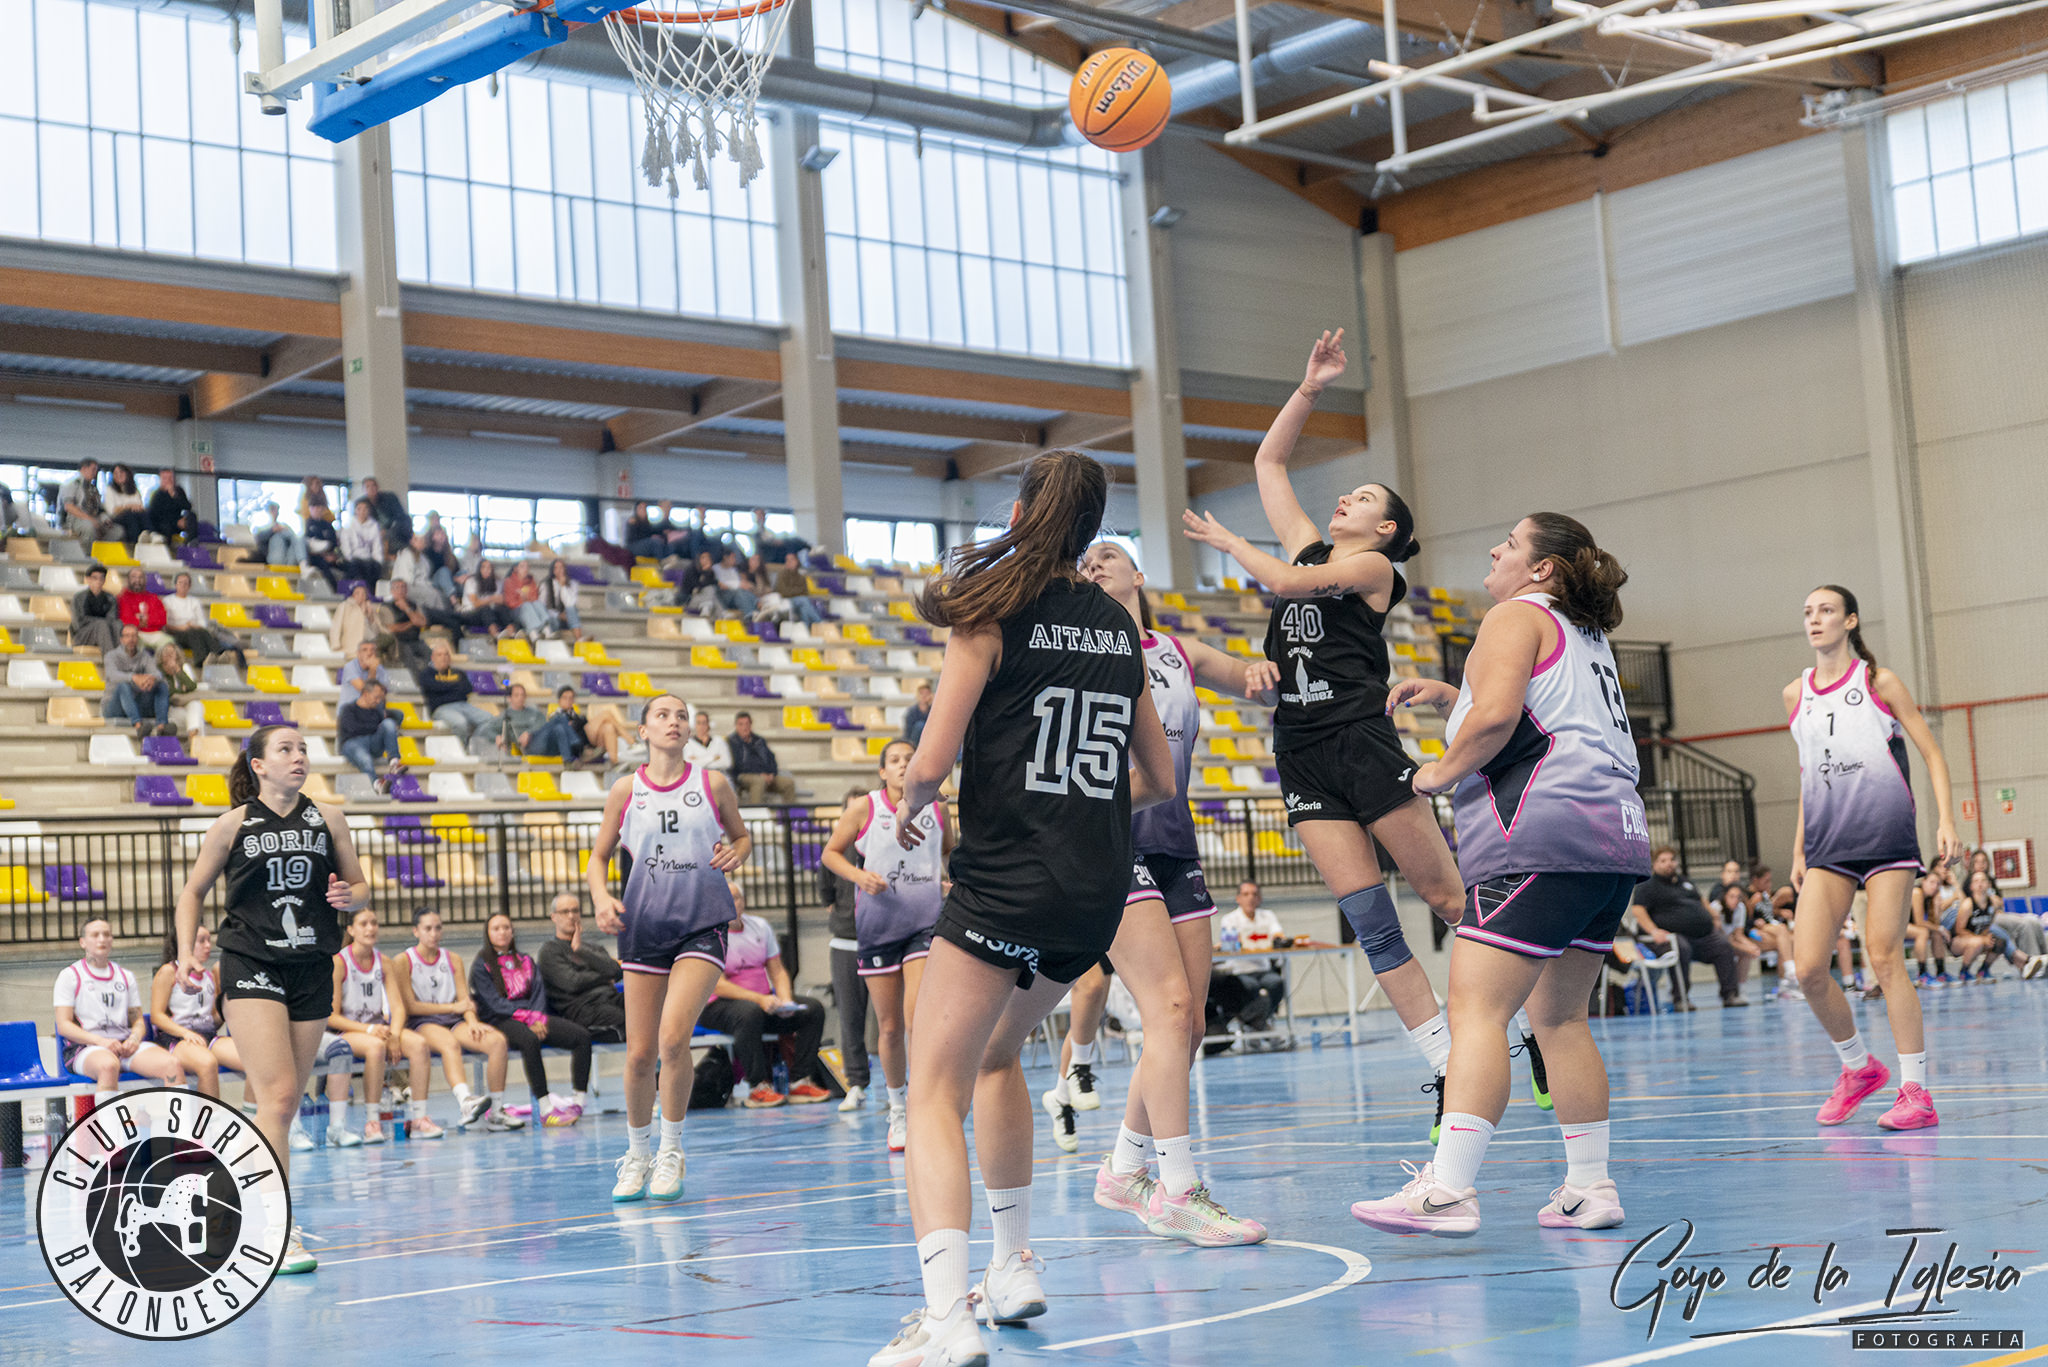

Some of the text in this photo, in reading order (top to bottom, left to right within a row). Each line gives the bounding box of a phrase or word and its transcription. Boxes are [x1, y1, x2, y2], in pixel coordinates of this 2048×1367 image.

[1095, 60, 1148, 113] Wilson
[1029, 623, 1132, 656] AITANA
[1280, 603, 1325, 643] 40
[1149, 667, 1170, 689] 4
[1025, 686, 1131, 800] 15
[657, 810, 679, 834] 12
[243, 830, 328, 858] SORIA
[266, 855, 313, 891] 19
[661, 859, 698, 872] Mansa
